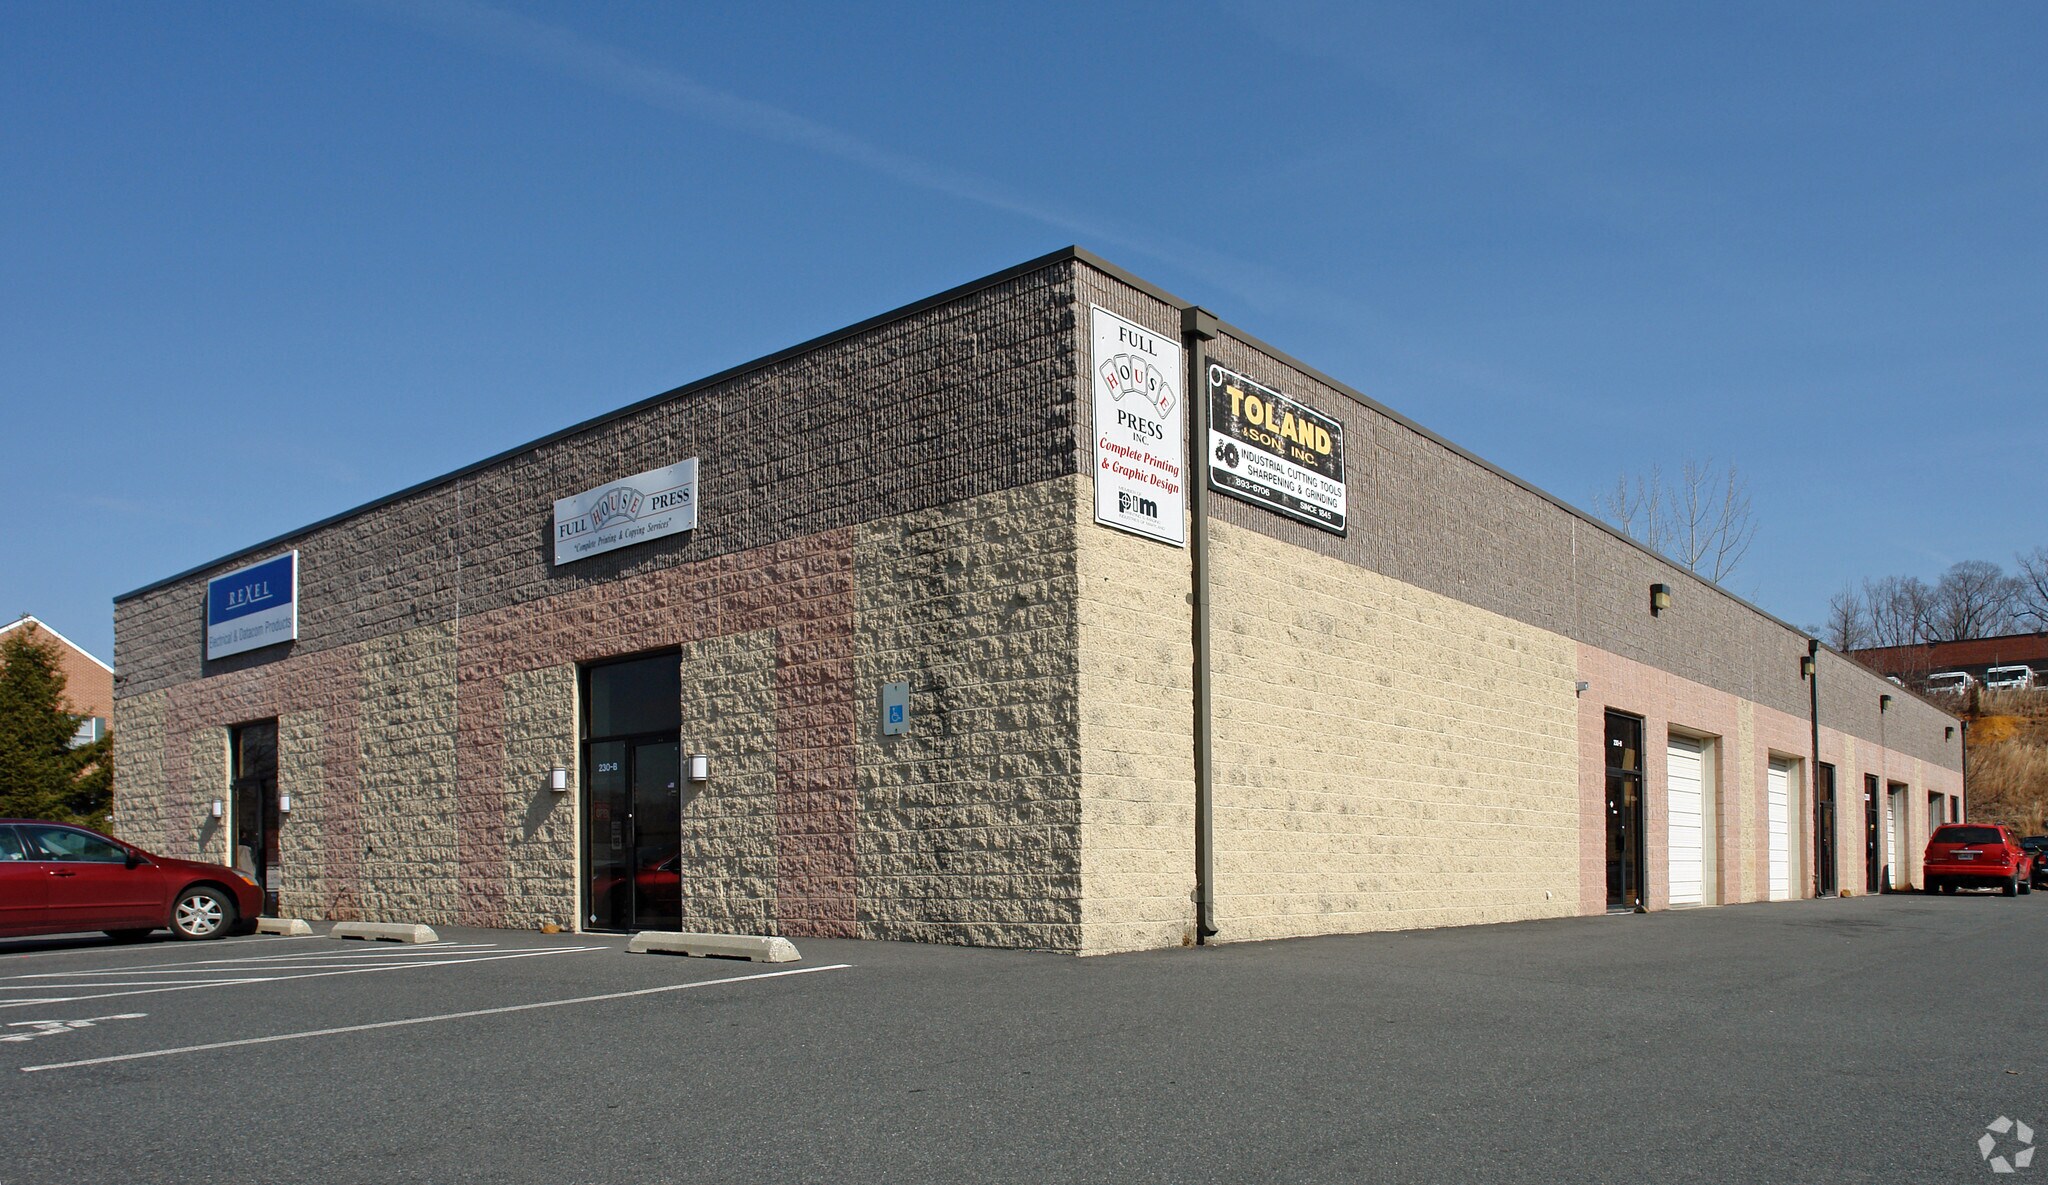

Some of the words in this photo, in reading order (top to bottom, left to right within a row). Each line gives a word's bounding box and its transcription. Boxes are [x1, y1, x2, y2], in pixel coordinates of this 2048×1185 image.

[1119, 326, 1158, 357] FULL
[1107, 365, 1169, 411] HOUSE
[1117, 408, 1163, 440] PRESS
[1226, 385, 1331, 455] TOLAND
[1132, 432, 1150, 446] INC.
[1099, 437, 1142, 463] Complete
[1144, 452, 1179, 478] Printing
[1291, 446, 1319, 467] INC.
[1101, 457, 1110, 470] &
[1112, 460, 1148, 483] Graphic
[1150, 473, 1179, 494] Design
[1241, 448, 1285, 475] INDUSTRIAL
[1287, 467, 1318, 488] CUTTING
[1320, 480, 1342, 498] TOOLS
[1247, 465, 1295, 492] SHARPENING
[1297, 484, 1303, 495] &
[1305, 487, 1338, 508] GRINDING
[559, 519, 587, 538] FULL
[593, 493, 639, 525] HOUSE
[652, 487, 690, 511] PRESS
[1300, 501, 1318, 515] SINCE
[618, 530, 623, 540] &
[624, 525, 645, 540] Copying
[228, 581, 270, 606] REXEL
[209, 631, 232, 649] Electrical
[233, 629, 238, 642] &
[239, 625, 264, 641] Datacom
[265, 617, 292, 634] Products
